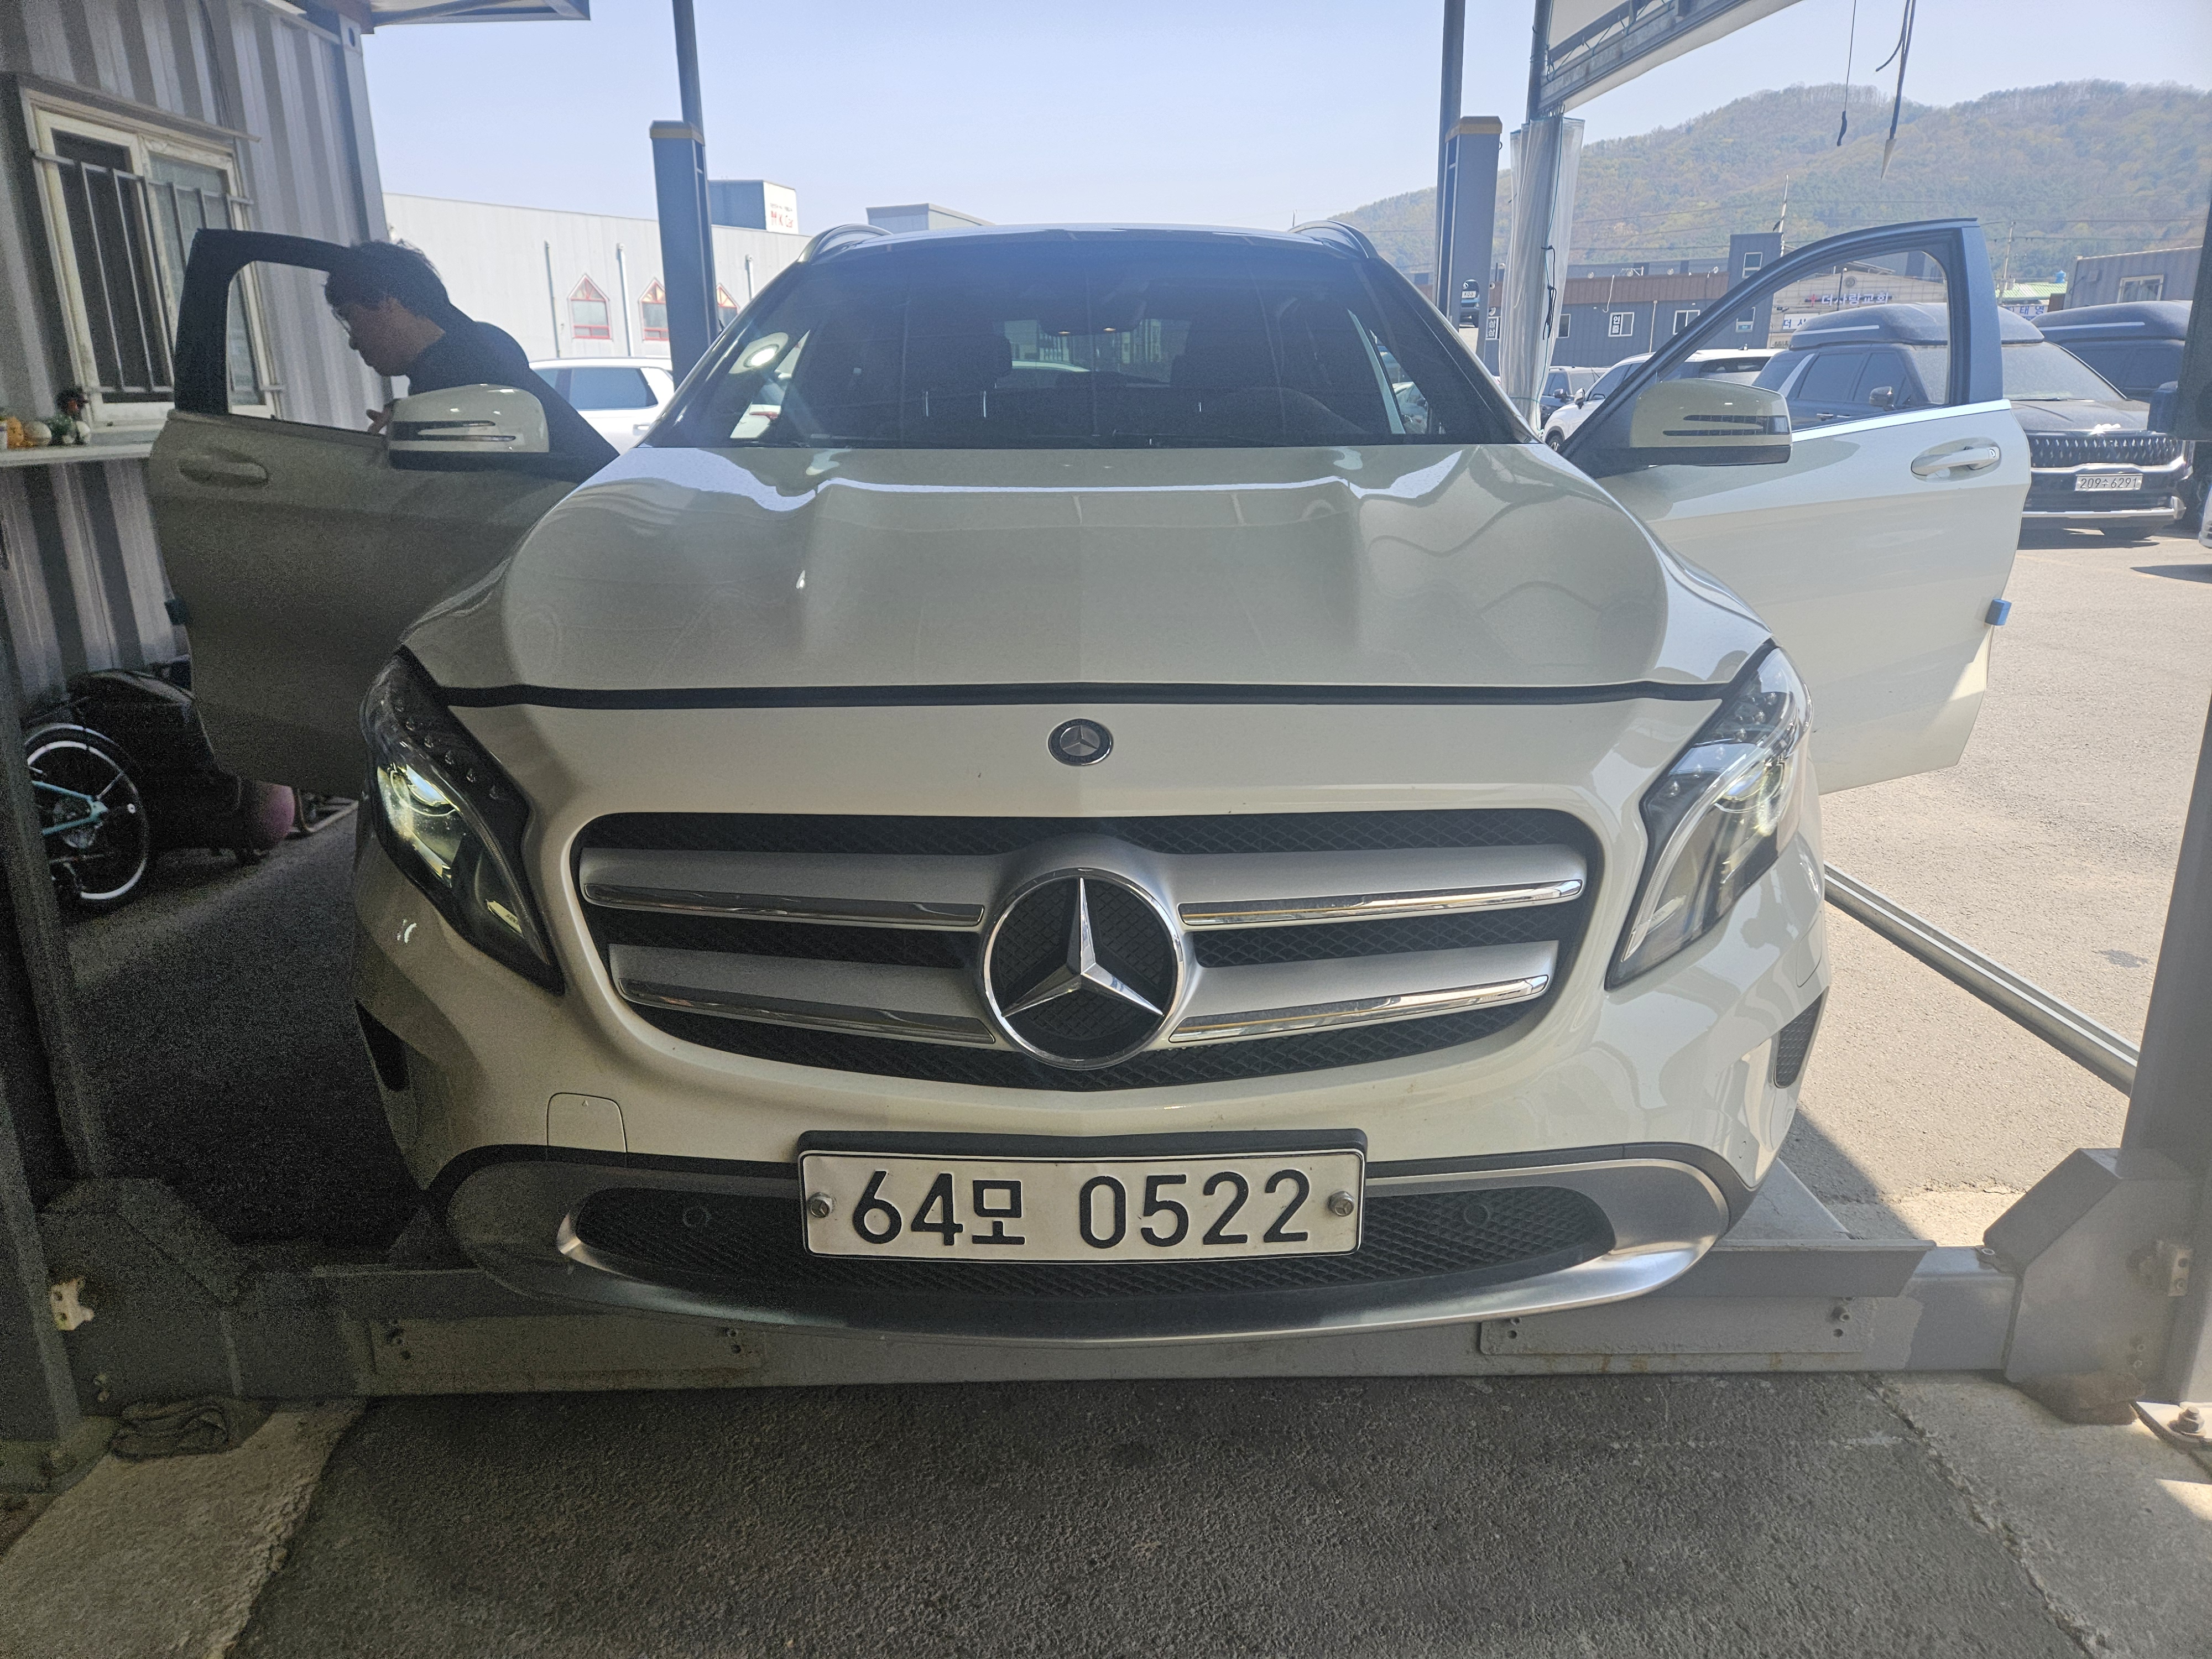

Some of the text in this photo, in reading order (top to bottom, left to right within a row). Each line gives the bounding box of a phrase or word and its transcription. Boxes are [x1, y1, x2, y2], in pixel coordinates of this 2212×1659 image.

[1821, 292, 1888, 306] 더사랑교회
[852, 1168, 1311, 1248] 64모 0522
